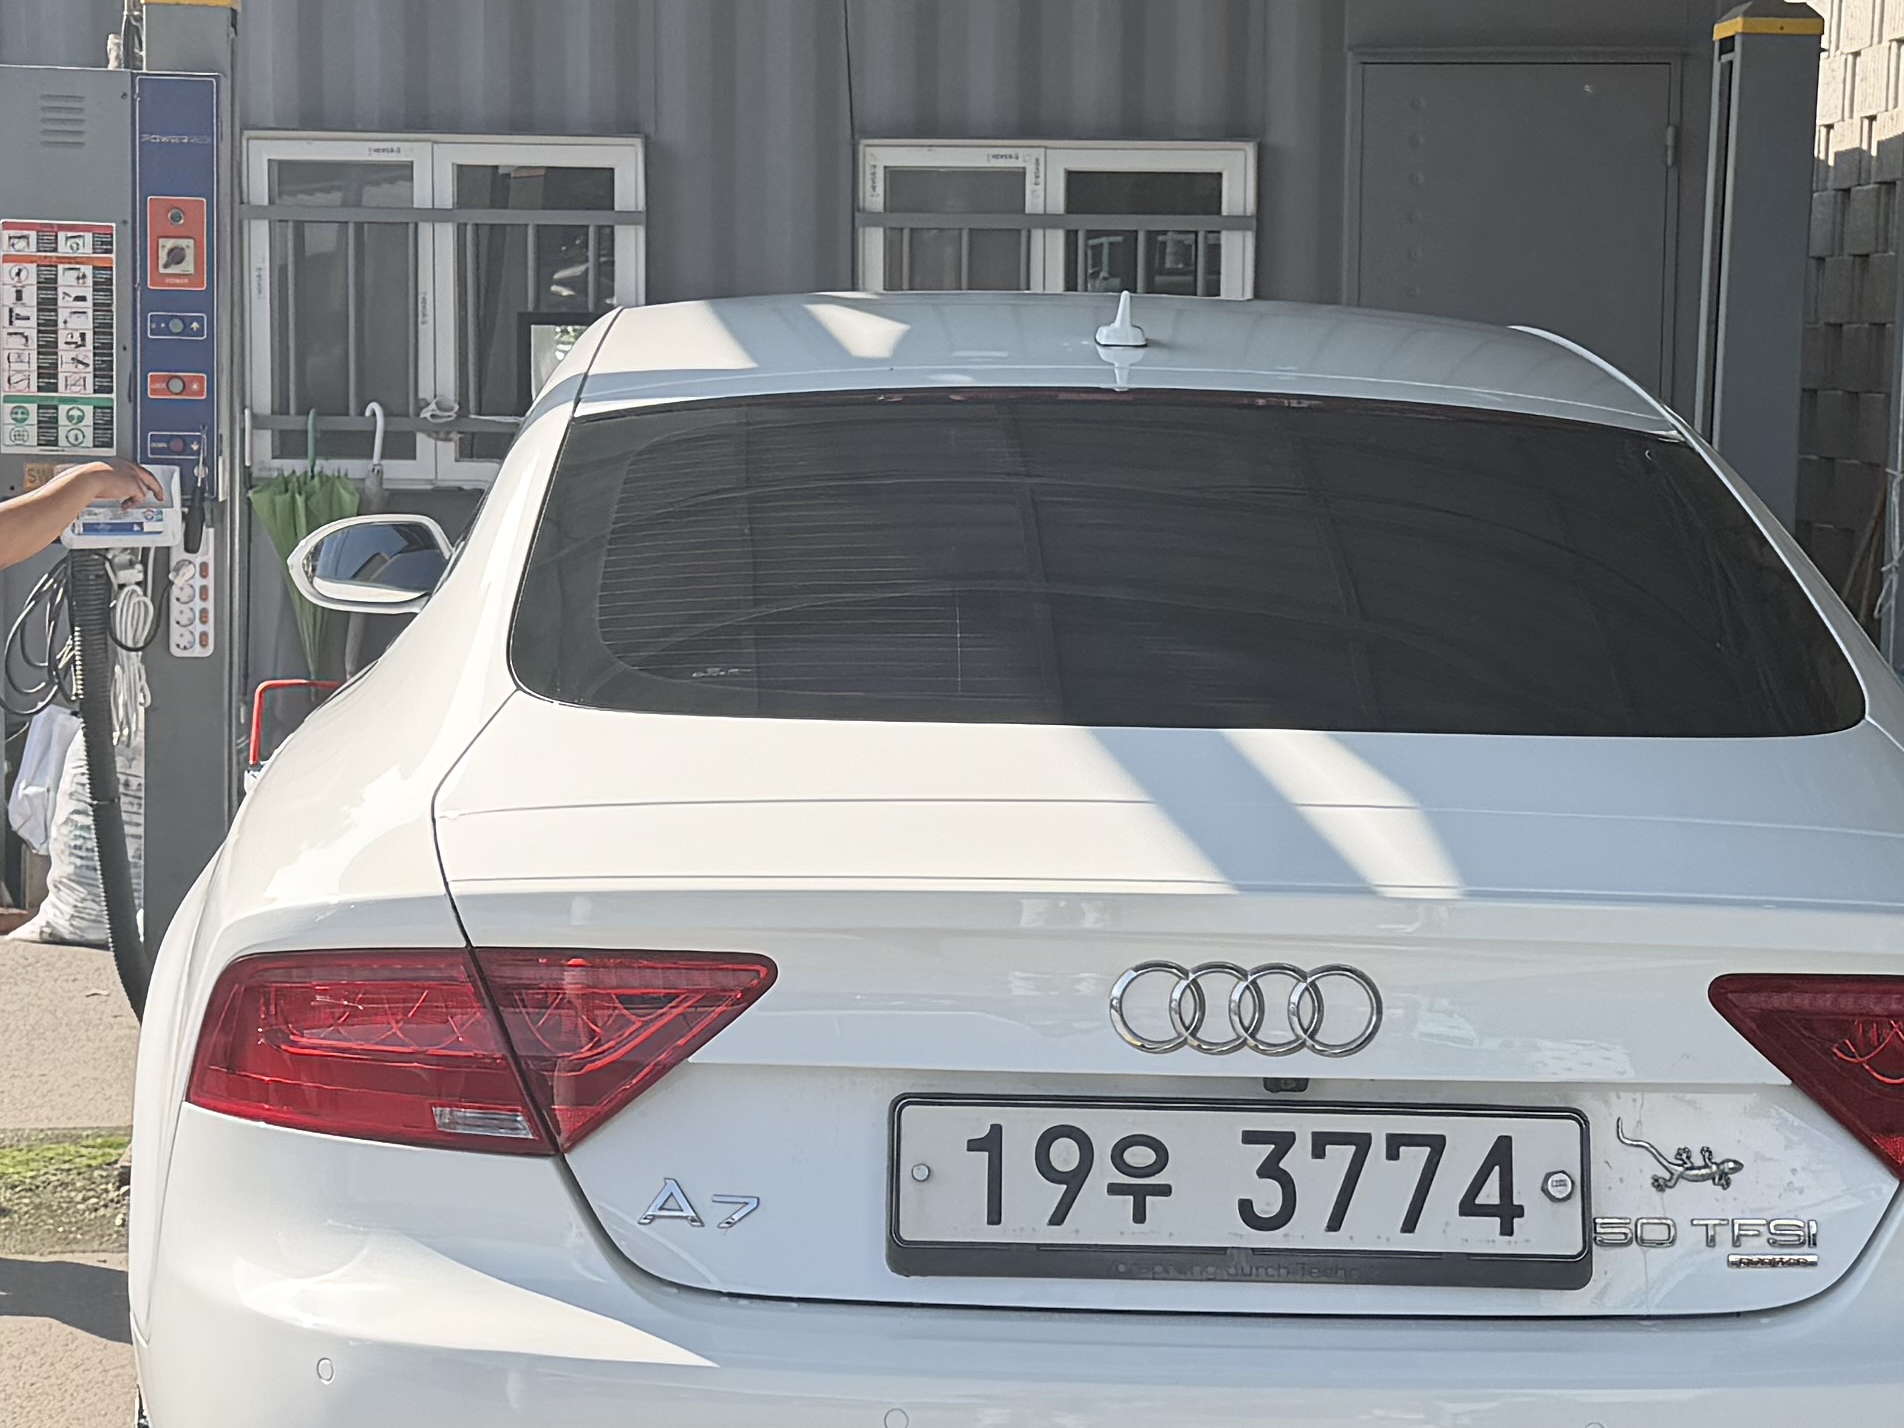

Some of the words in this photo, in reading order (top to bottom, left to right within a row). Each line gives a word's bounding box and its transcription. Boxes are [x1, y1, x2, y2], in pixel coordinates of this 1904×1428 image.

[637, 1177, 760, 1229] A7
[967, 1123, 1173, 1226] 19우
[1238, 1130, 1525, 1236] 3774
[1593, 1217, 1677, 1247] 50
[1691, 1218, 1818, 1248] TFSI
